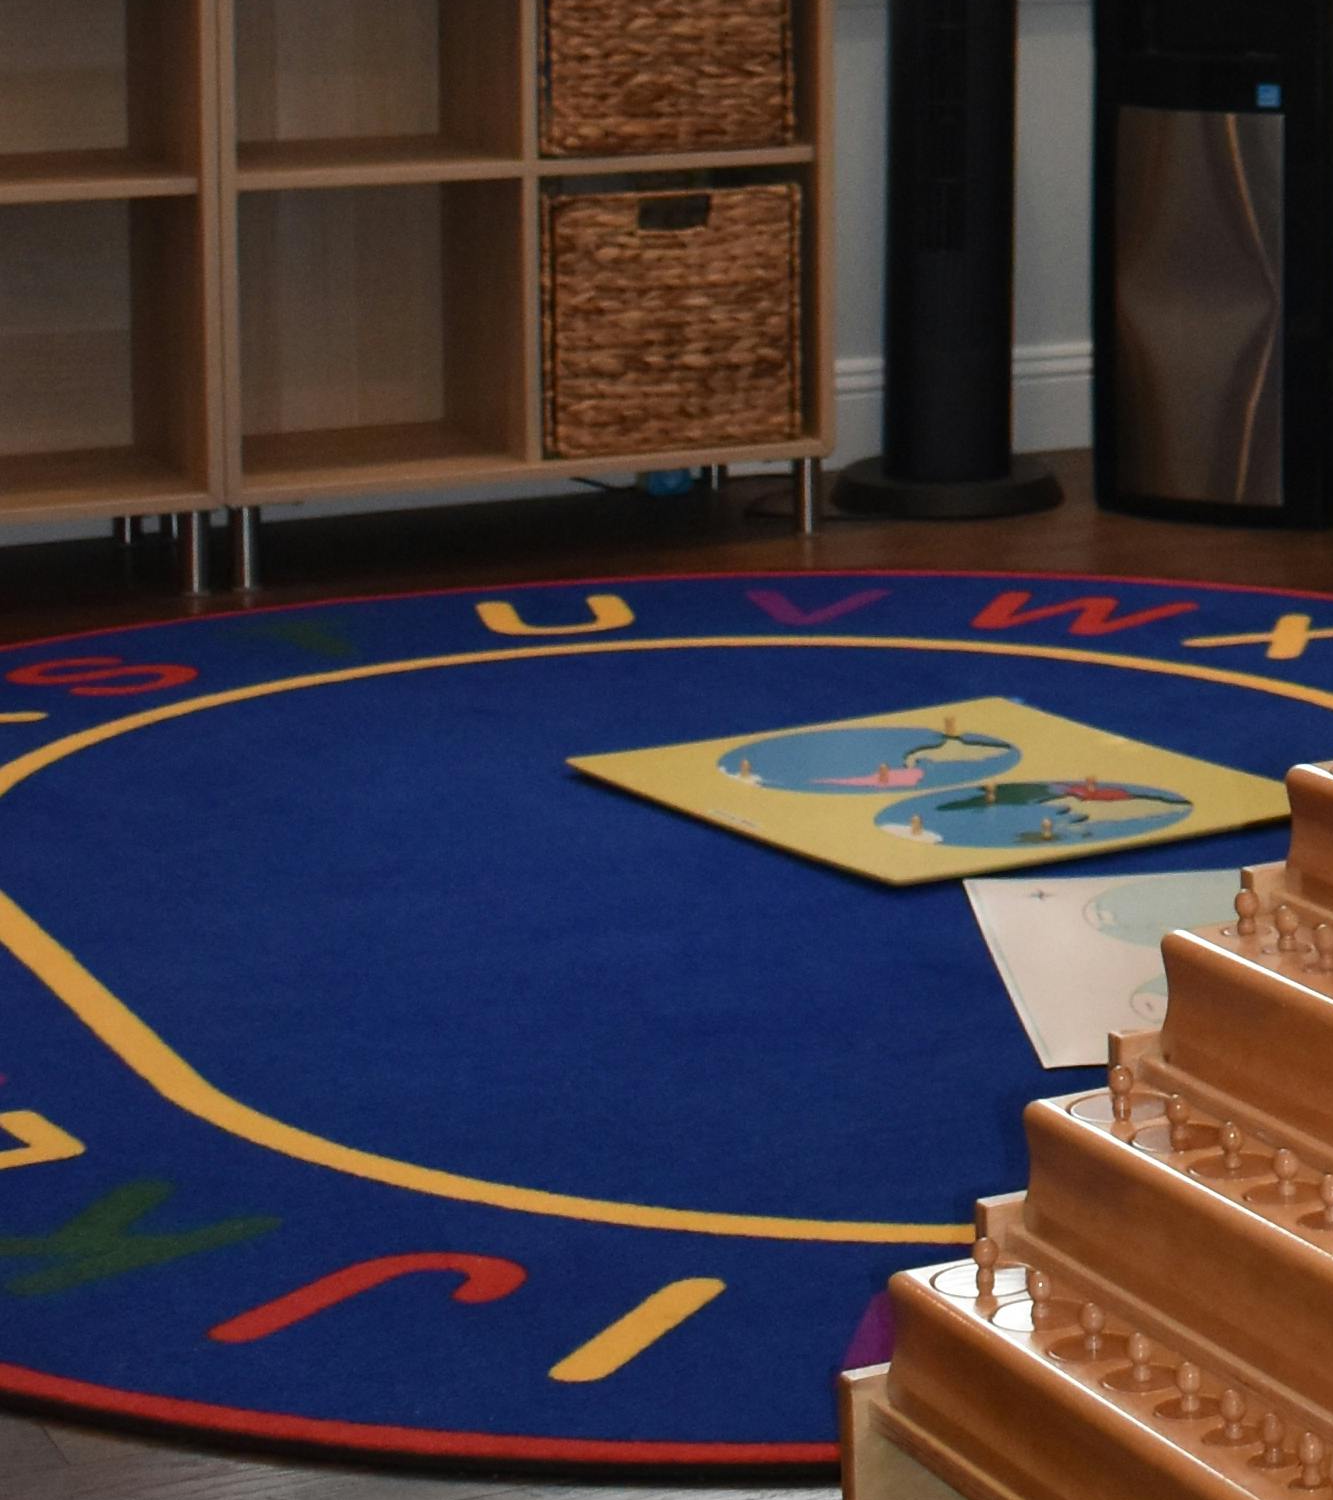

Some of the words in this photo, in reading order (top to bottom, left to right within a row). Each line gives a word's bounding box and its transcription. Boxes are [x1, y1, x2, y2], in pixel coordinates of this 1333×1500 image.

[4, 656, 199, 697] S
[475, 594, 635, 636] U
[747, 589, 892, 625] V
[972, 590, 1199, 635] W
[207, 1251, 528, 1344] J
